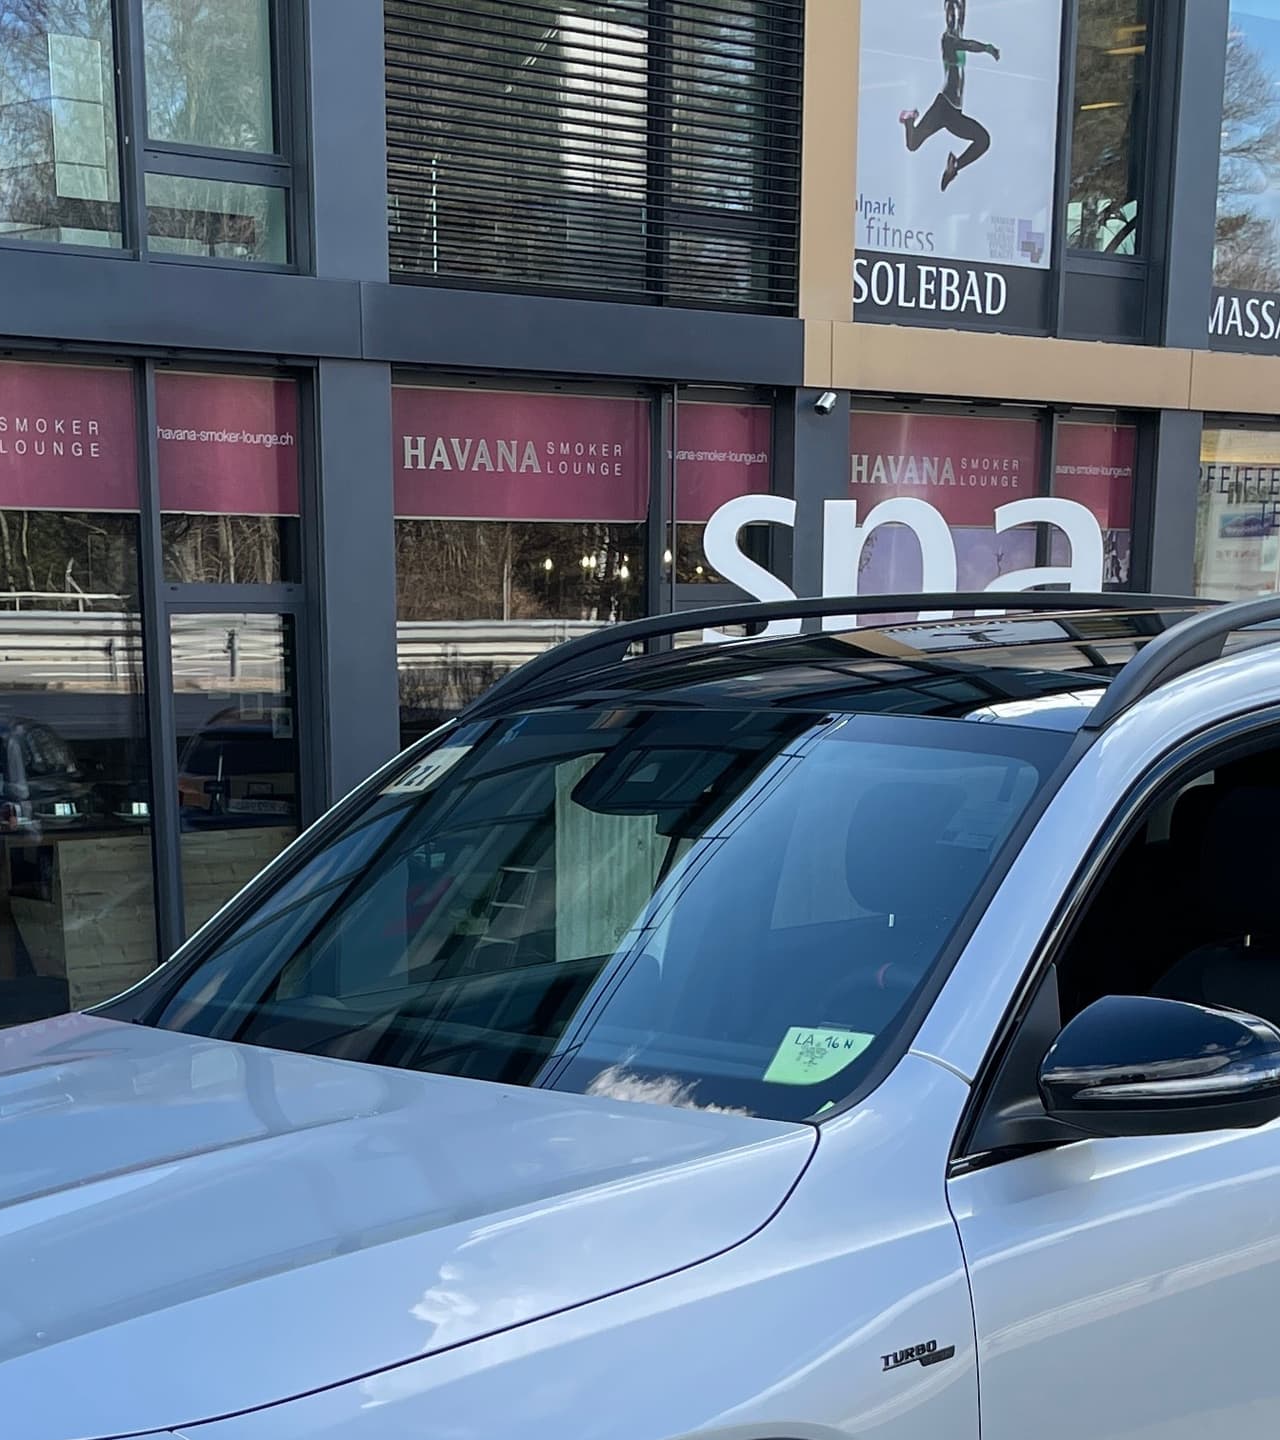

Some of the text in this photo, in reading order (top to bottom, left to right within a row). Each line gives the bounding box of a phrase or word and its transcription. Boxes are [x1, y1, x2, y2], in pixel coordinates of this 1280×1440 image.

[866, 217, 934, 252] fitness
[853, 259, 1007, 315] SOLEBAD
[0, 440, 100, 457] LOUNGE
[157, 425, 294, 447] havana-smoker-lounge.ch
[403, 436, 623, 474] HAVANA SMOKER
[547, 461, 623, 477] LOUNGE
[851, 454, 1019, 486] HAVANA SMOKER
[960, 475, 1018, 488] LOUNGE
[881, 1339, 937, 1367] TURBO
